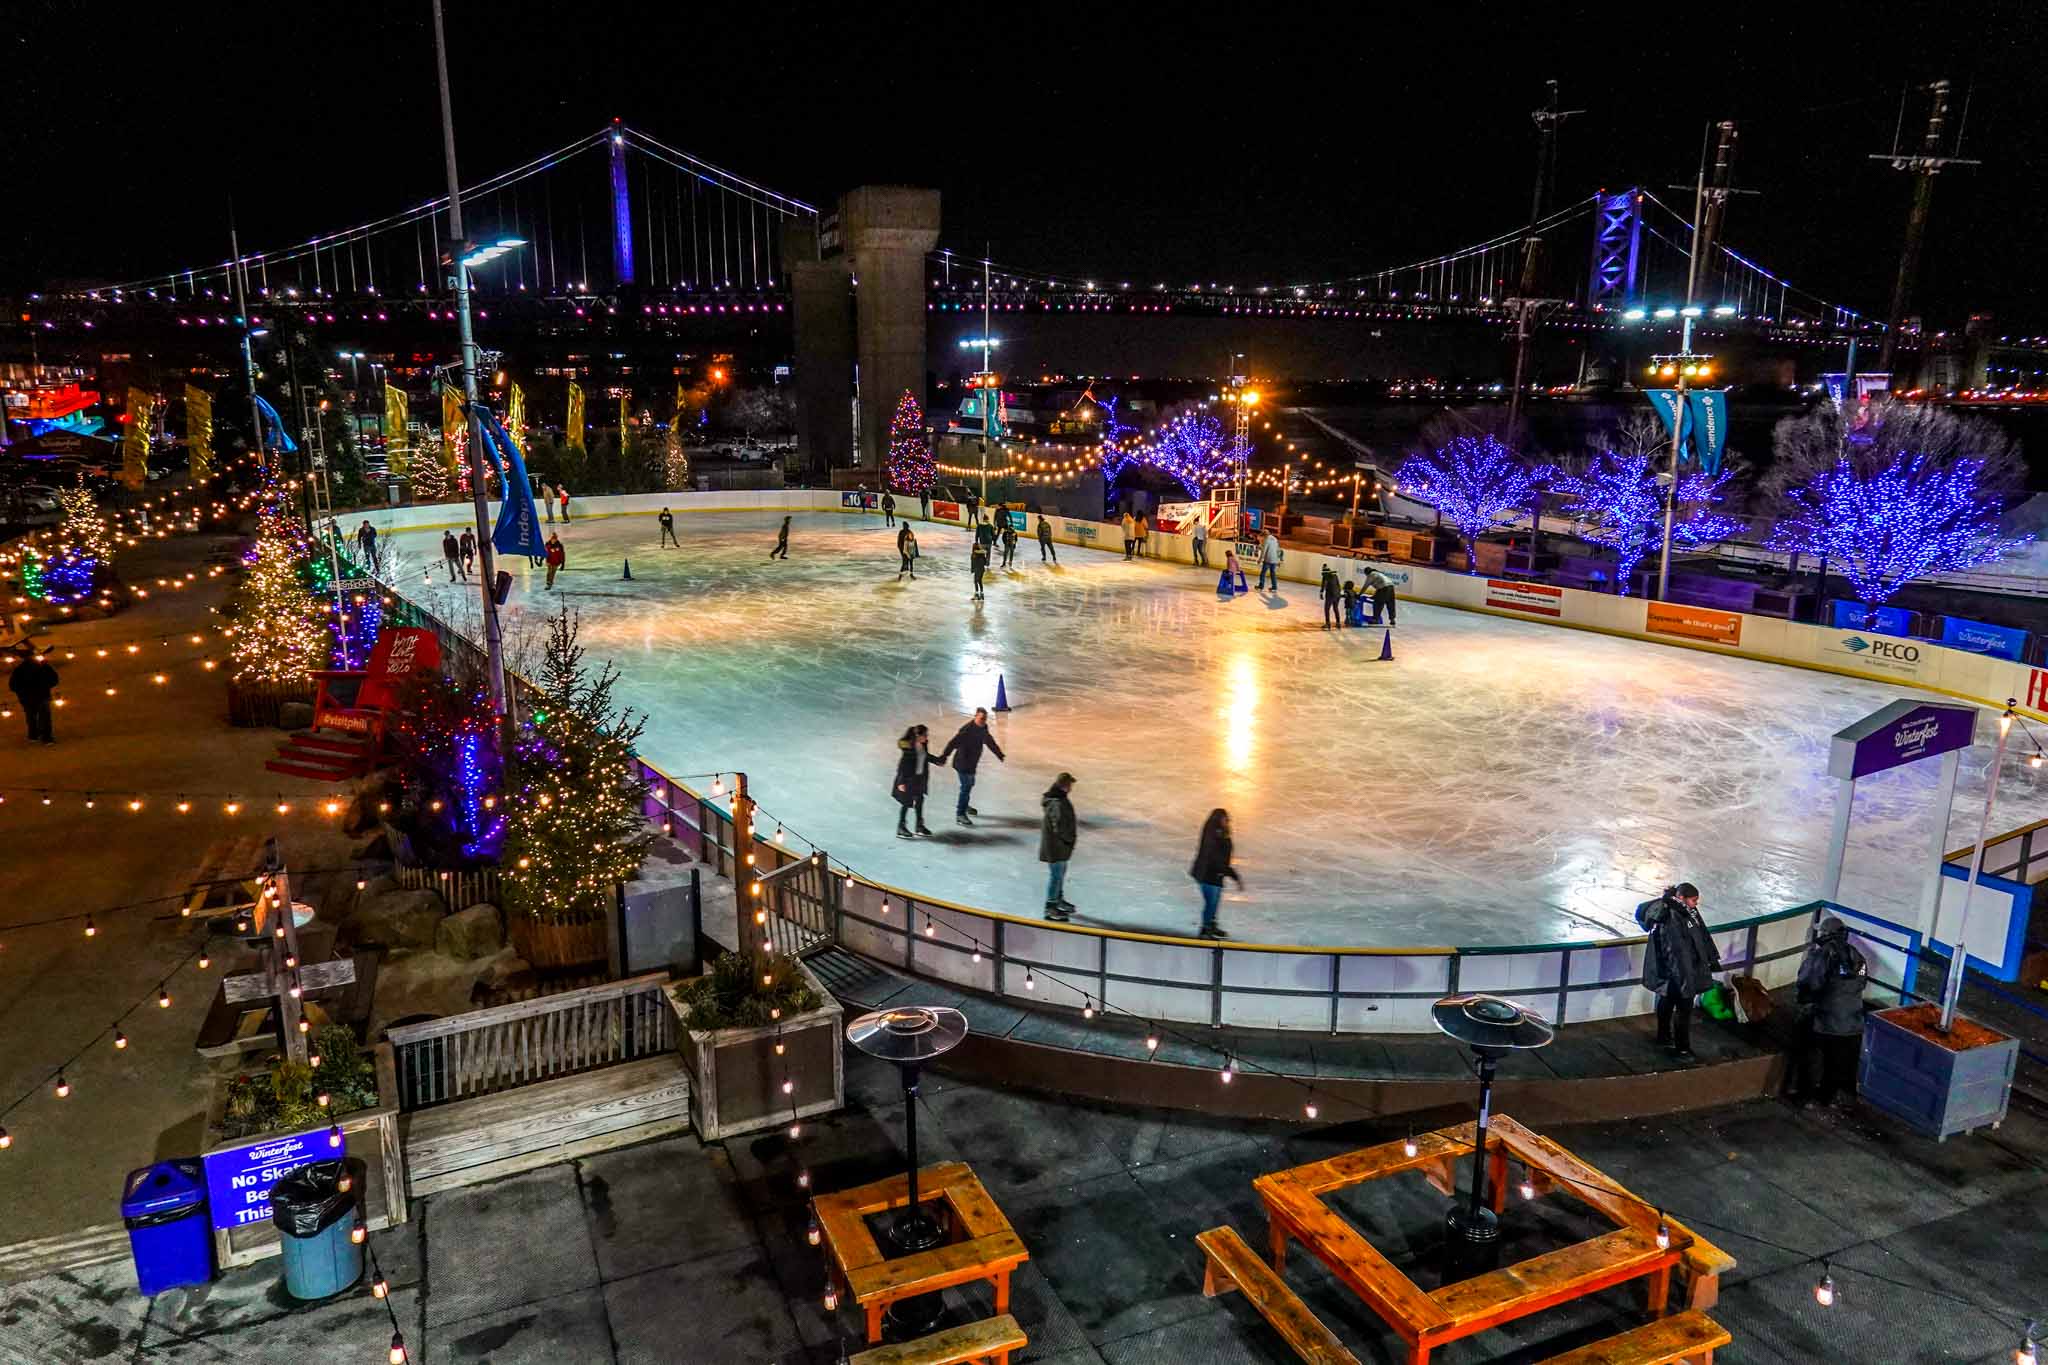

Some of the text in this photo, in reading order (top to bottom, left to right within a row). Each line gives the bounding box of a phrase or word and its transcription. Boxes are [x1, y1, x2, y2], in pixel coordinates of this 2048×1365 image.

[849, 493, 861, 507] 10
[1872, 640, 1919, 662] PECO
[1895, 723, 1938, 747] Winterfest
[249, 1141, 303, 1160] Winterfest
[231, 1162, 311, 1190] No Skat
[246, 1188, 271, 1204] Be
[235, 1205, 273, 1222] This
